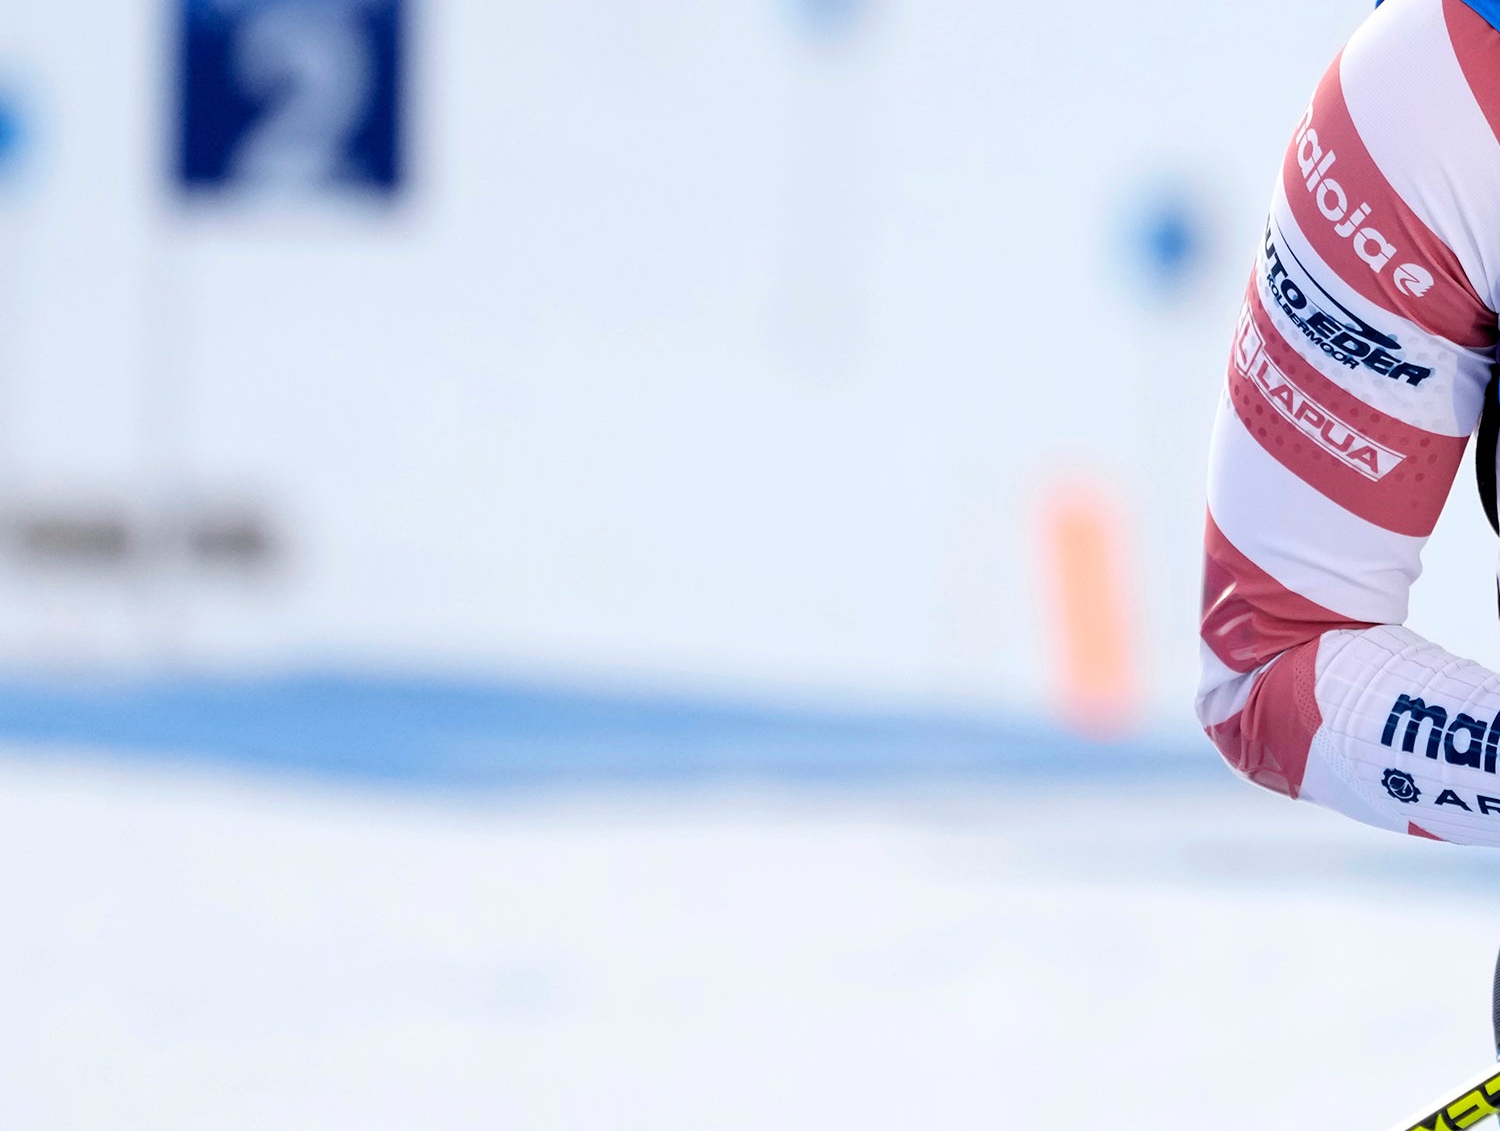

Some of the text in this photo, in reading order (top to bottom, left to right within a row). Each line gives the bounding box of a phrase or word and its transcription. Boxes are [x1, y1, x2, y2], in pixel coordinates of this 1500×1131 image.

[1264, 219, 1432, 387] UTO EDER
[1266, 273, 1361, 371] KOLBERMOOR
[1256, 361, 1381, 475] LAPUA
